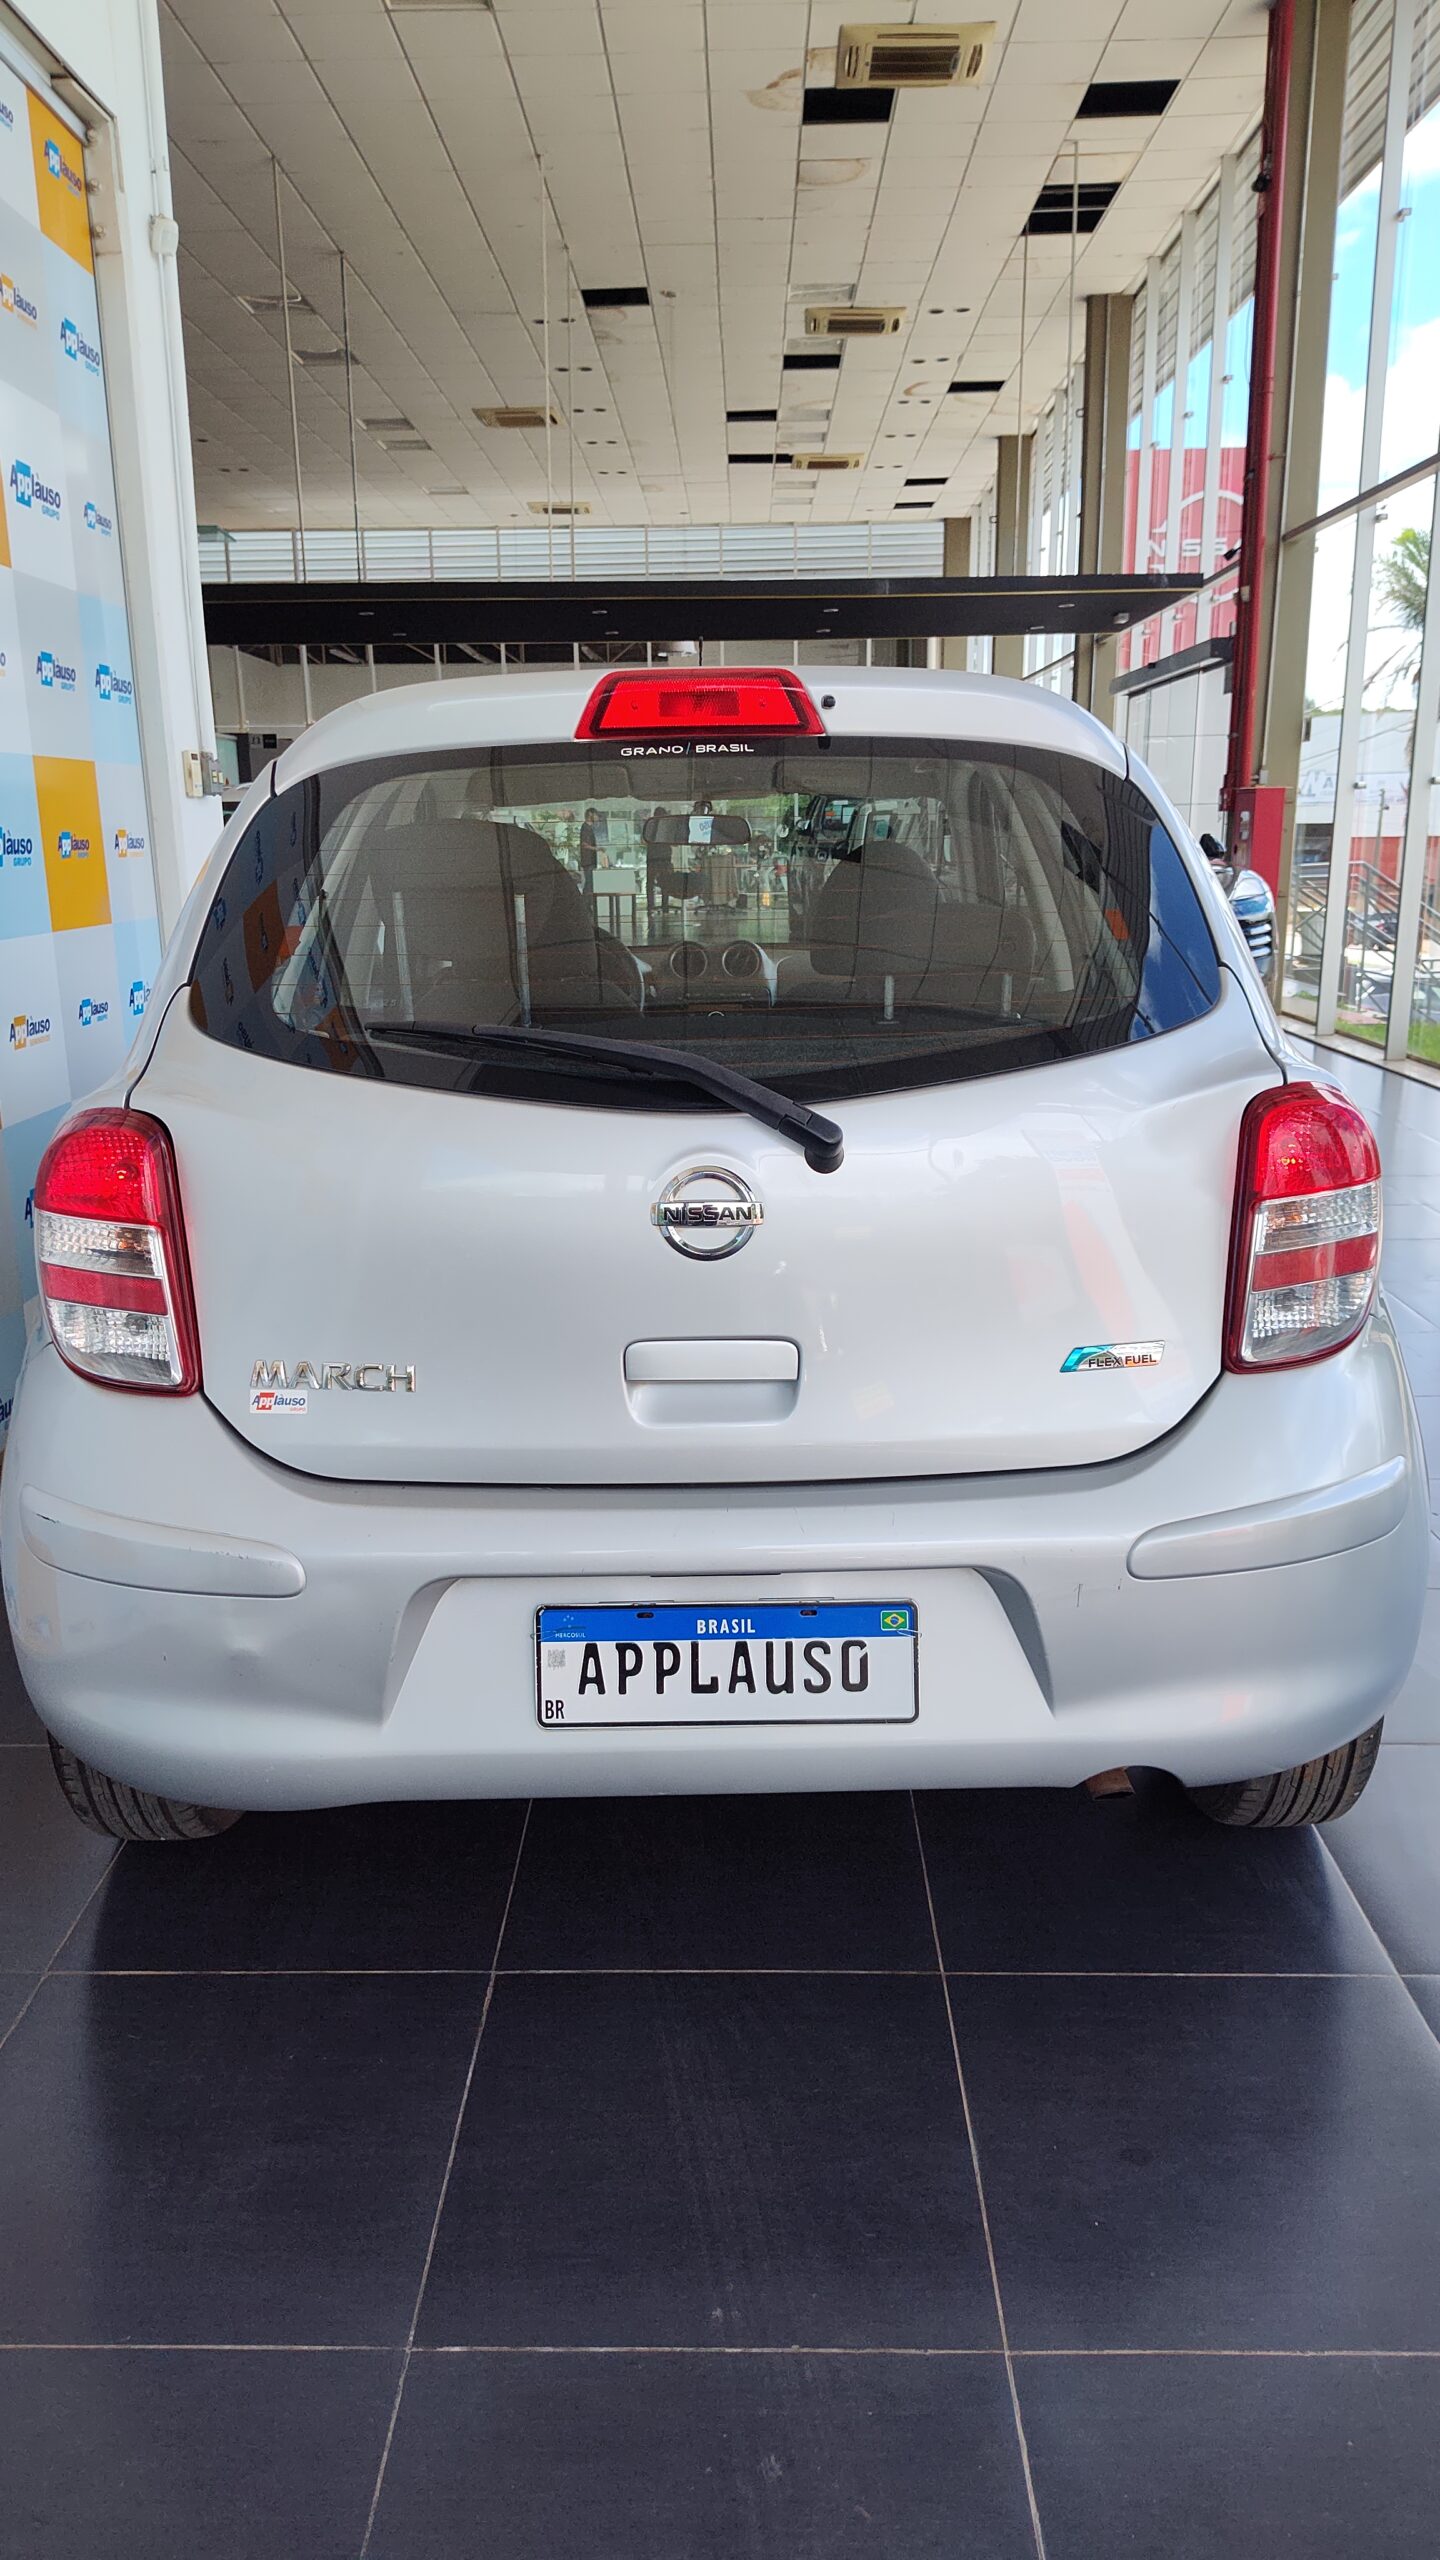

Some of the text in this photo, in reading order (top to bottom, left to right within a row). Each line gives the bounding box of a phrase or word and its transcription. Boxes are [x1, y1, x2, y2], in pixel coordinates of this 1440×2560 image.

[621, 745, 684, 757] GRANO
[695, 743, 755, 754] BRASIL
[663, 1206, 753, 1221] NISSAN
[1088, 1354, 1157, 1368] FLEX FUEL
[250, 1359, 416, 1393] MARCH
[697, 1619, 756, 1635] BRASIL
[544, 1700, 565, 1720] BR
